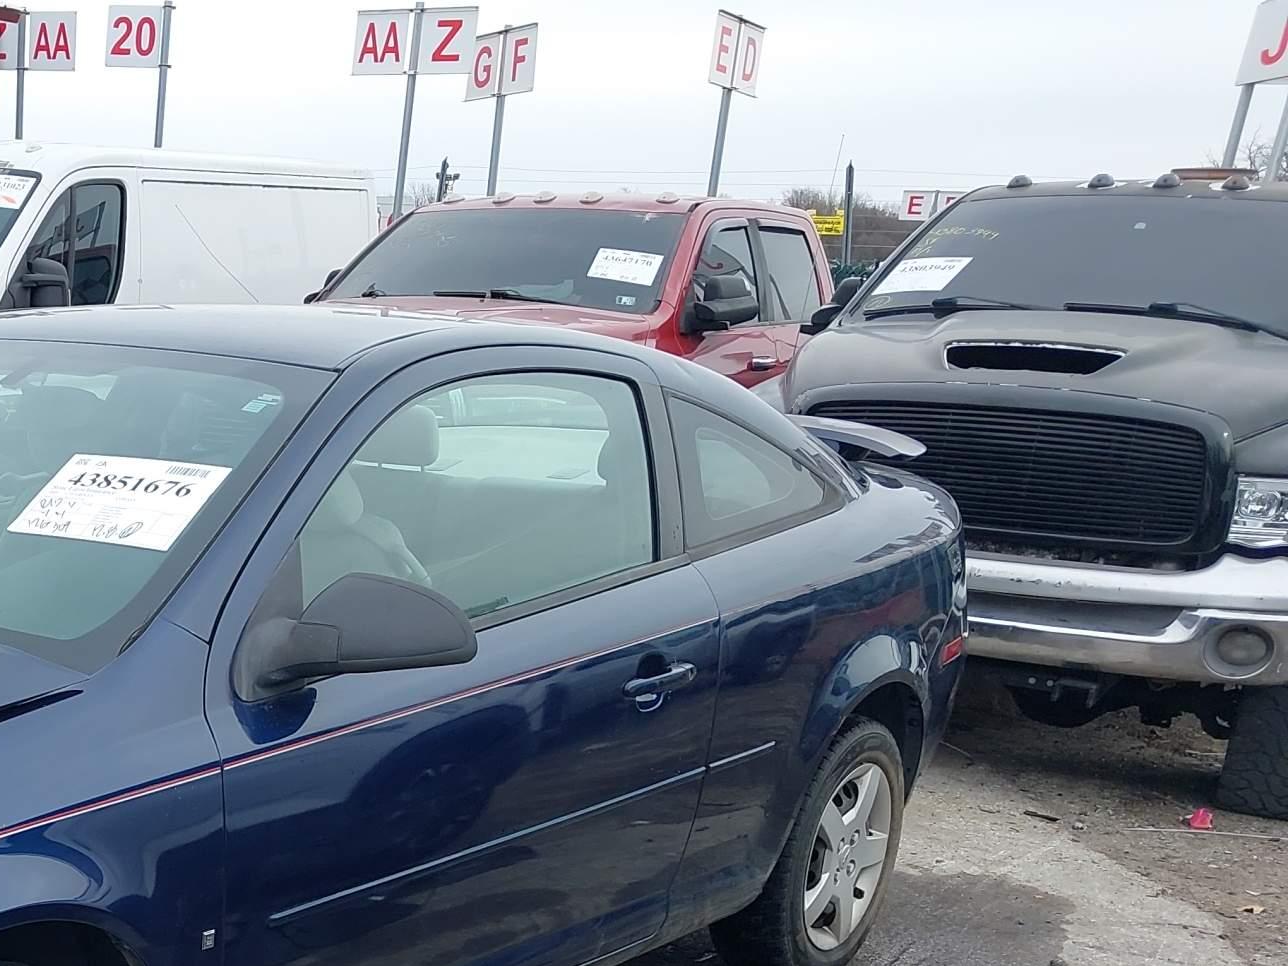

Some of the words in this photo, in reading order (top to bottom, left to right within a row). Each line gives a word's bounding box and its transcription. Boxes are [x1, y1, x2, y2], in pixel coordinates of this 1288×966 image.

[33, 22, 71, 60] AA
[110, 15, 157, 57] 20
[358, 21, 401, 63] AA
[431, 19, 464, 62] Z
[715, 27, 733, 75] E
[473, 45, 492, 88] G
[511, 37, 529, 82] F
[741, 41, 758, 82] D
[906, 195, 925, 215] E
[68, 471, 193, 498] 43851676
